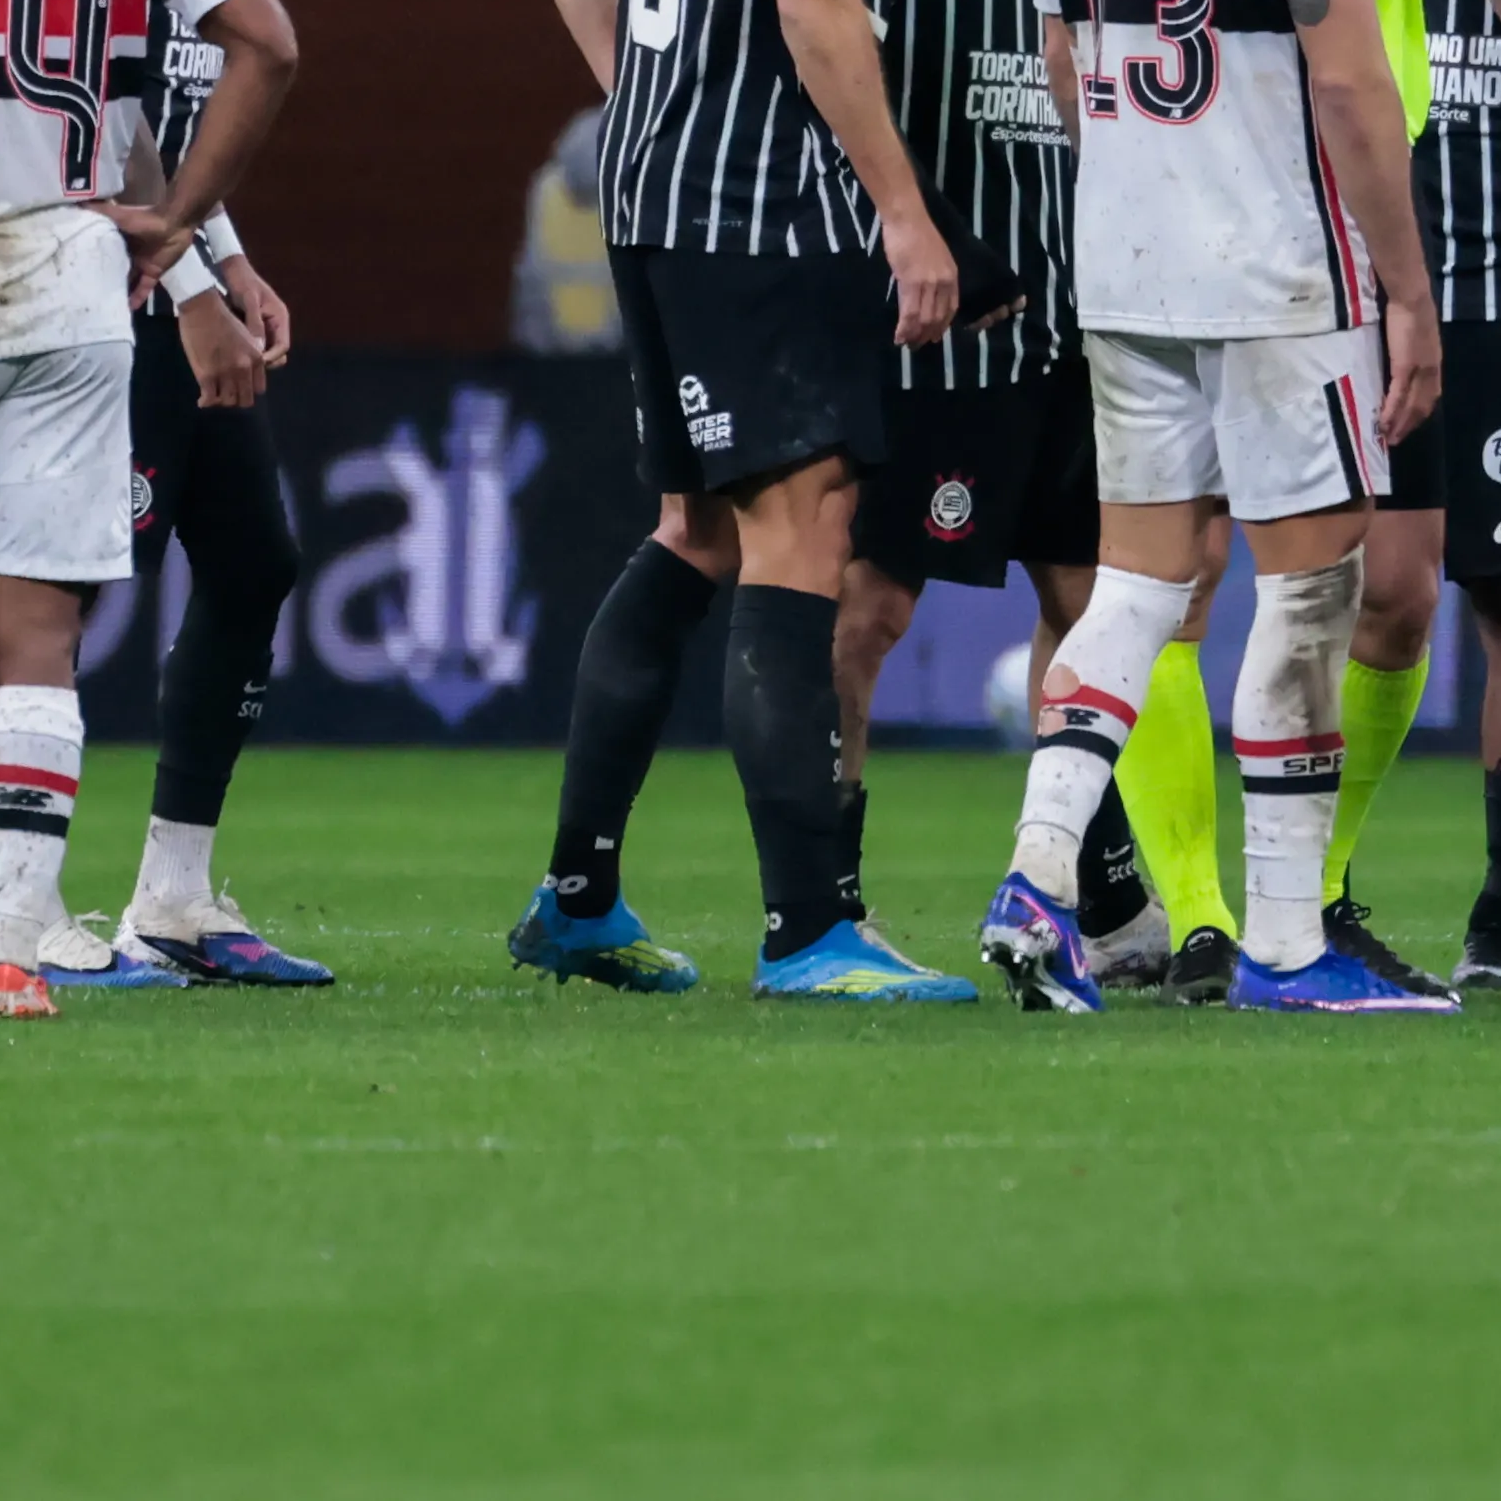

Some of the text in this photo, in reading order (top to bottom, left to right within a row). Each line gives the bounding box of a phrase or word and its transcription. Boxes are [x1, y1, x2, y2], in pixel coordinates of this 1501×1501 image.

[969, 50, 1033, 87] TORÇA
[1429, 105, 1471, 124] Sorte
[1283, 751, 1345, 774] SPF
